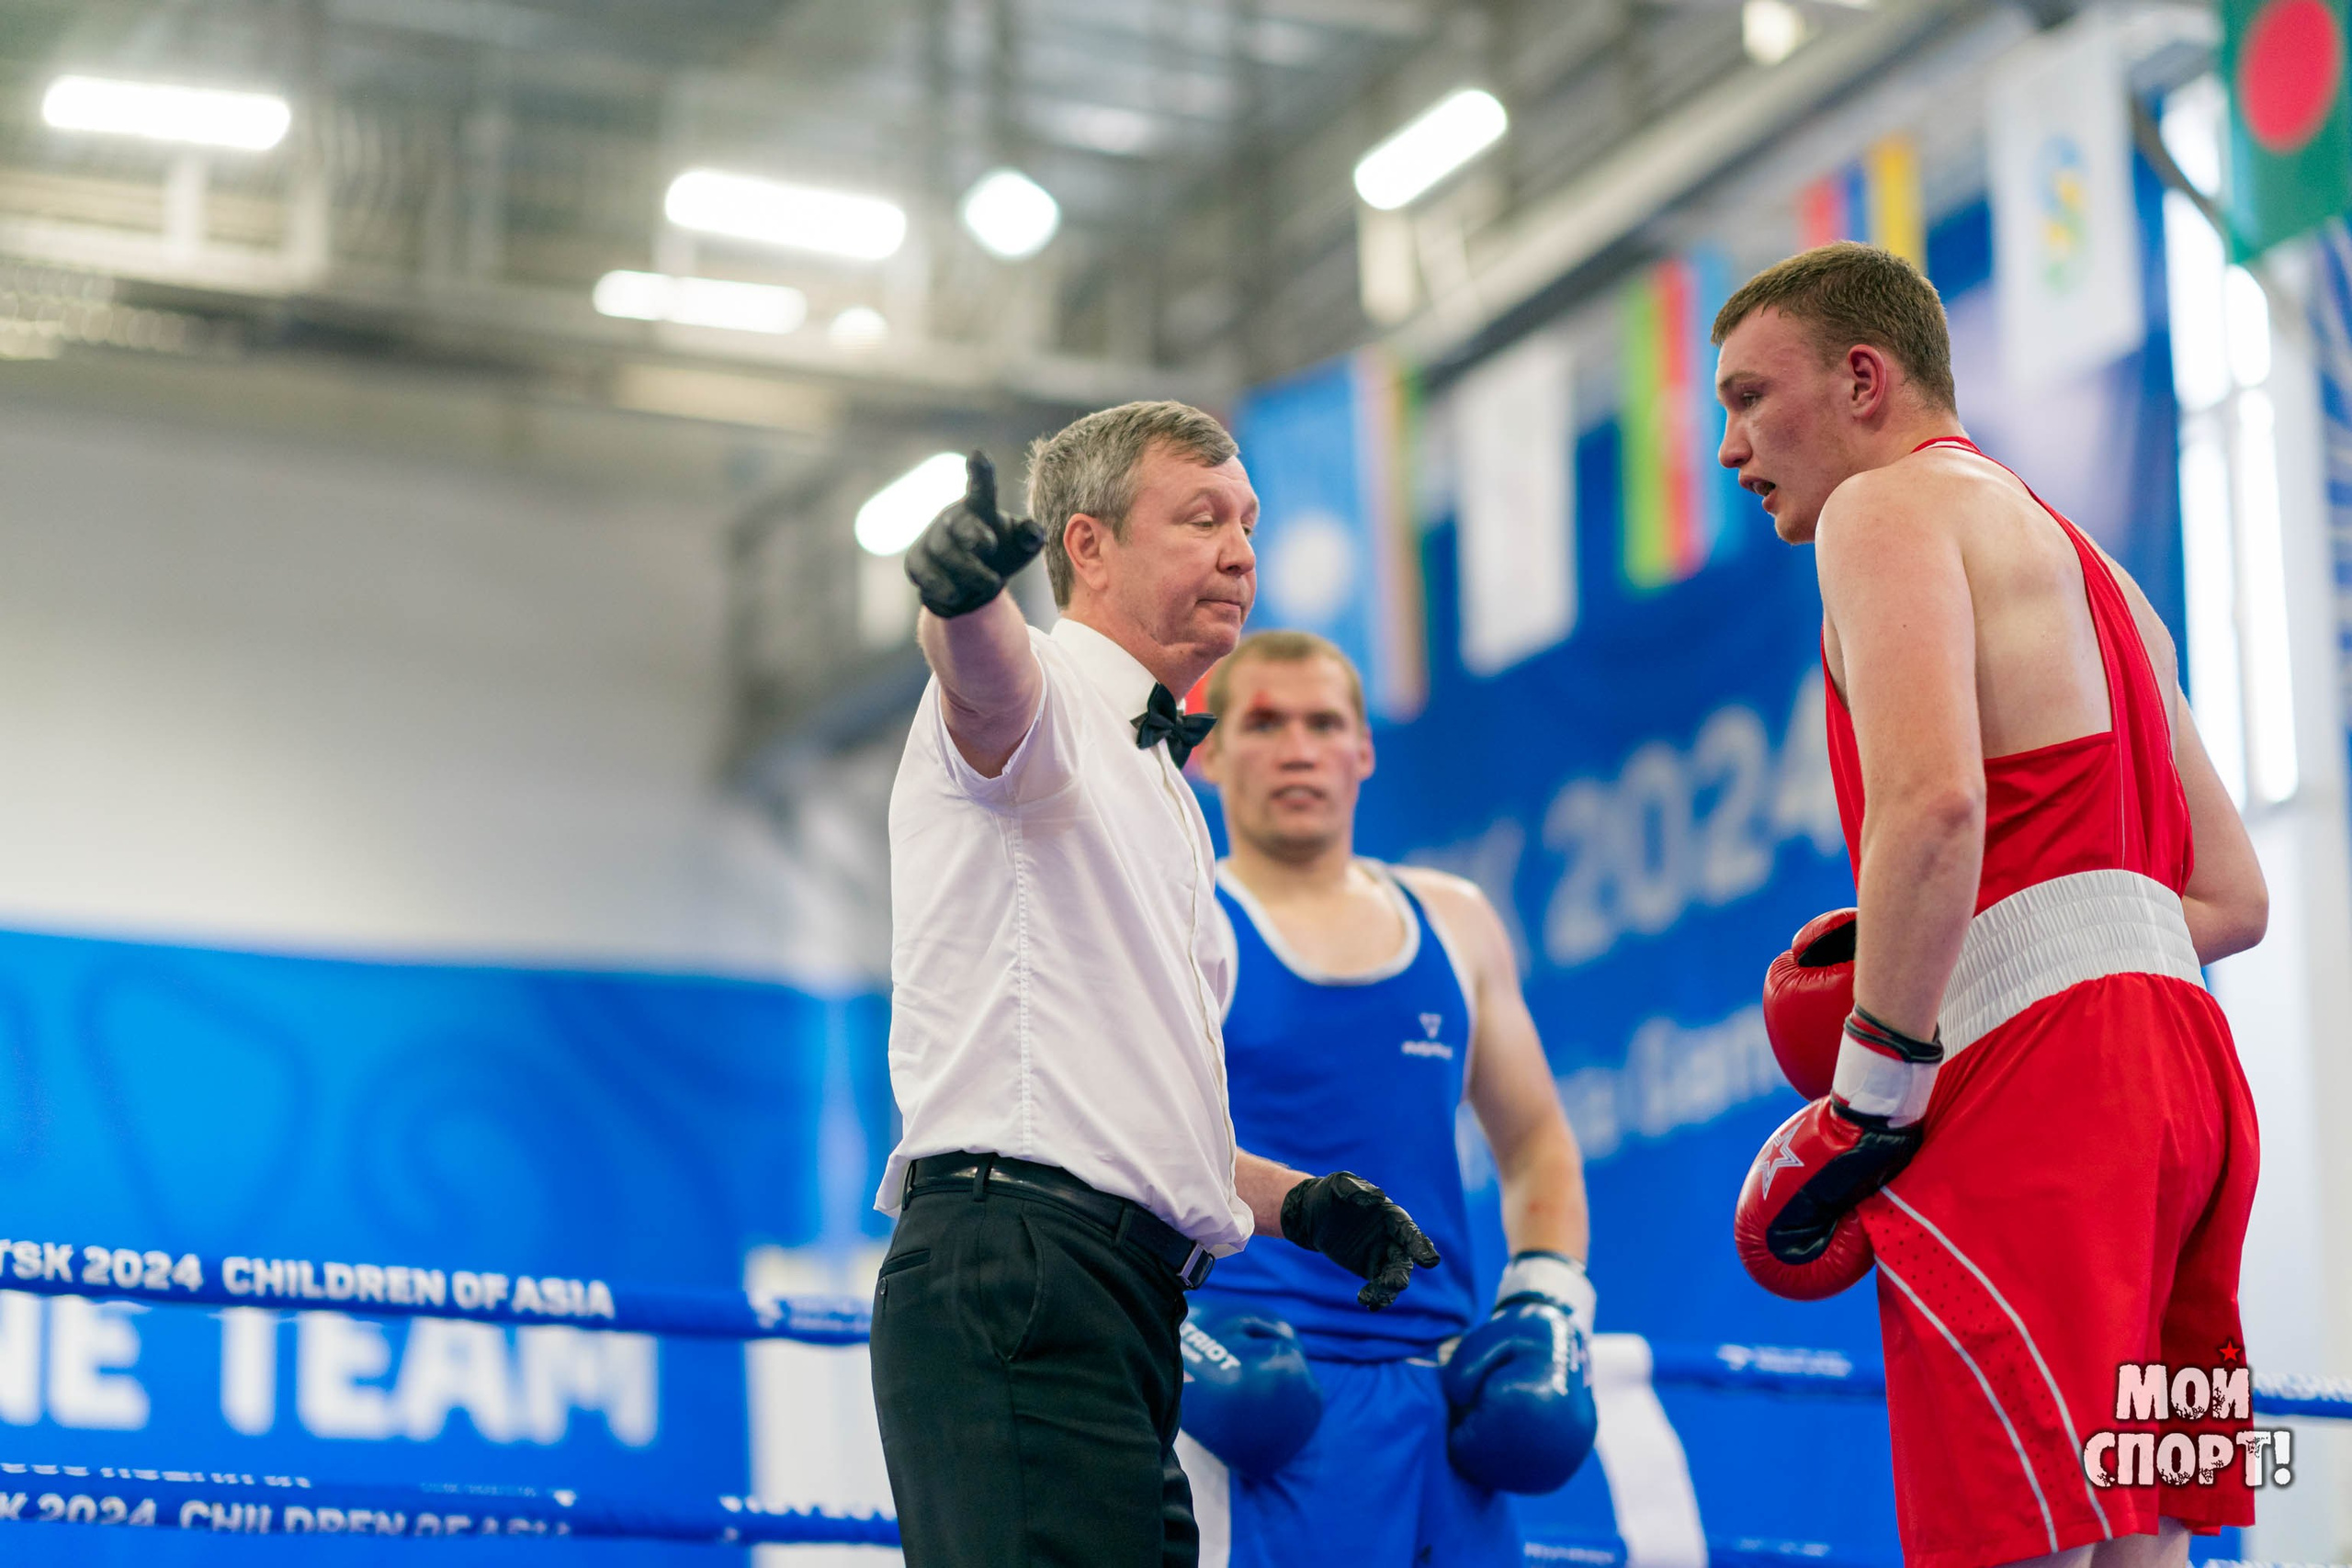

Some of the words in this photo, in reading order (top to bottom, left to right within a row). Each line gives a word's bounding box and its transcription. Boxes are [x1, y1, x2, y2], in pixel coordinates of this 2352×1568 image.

[82, 1245, 204, 1292] 2024
[221, 1256, 447, 1307] CHILDREN
[451, 1270, 509, 1310] OF
[512, 1275, 616, 1320] ASIA
[219, 1303, 662, 1448] TEAM
[1180, 1322, 1242, 1370] TRIOT
[37, 1493, 157, 1527] 2024
